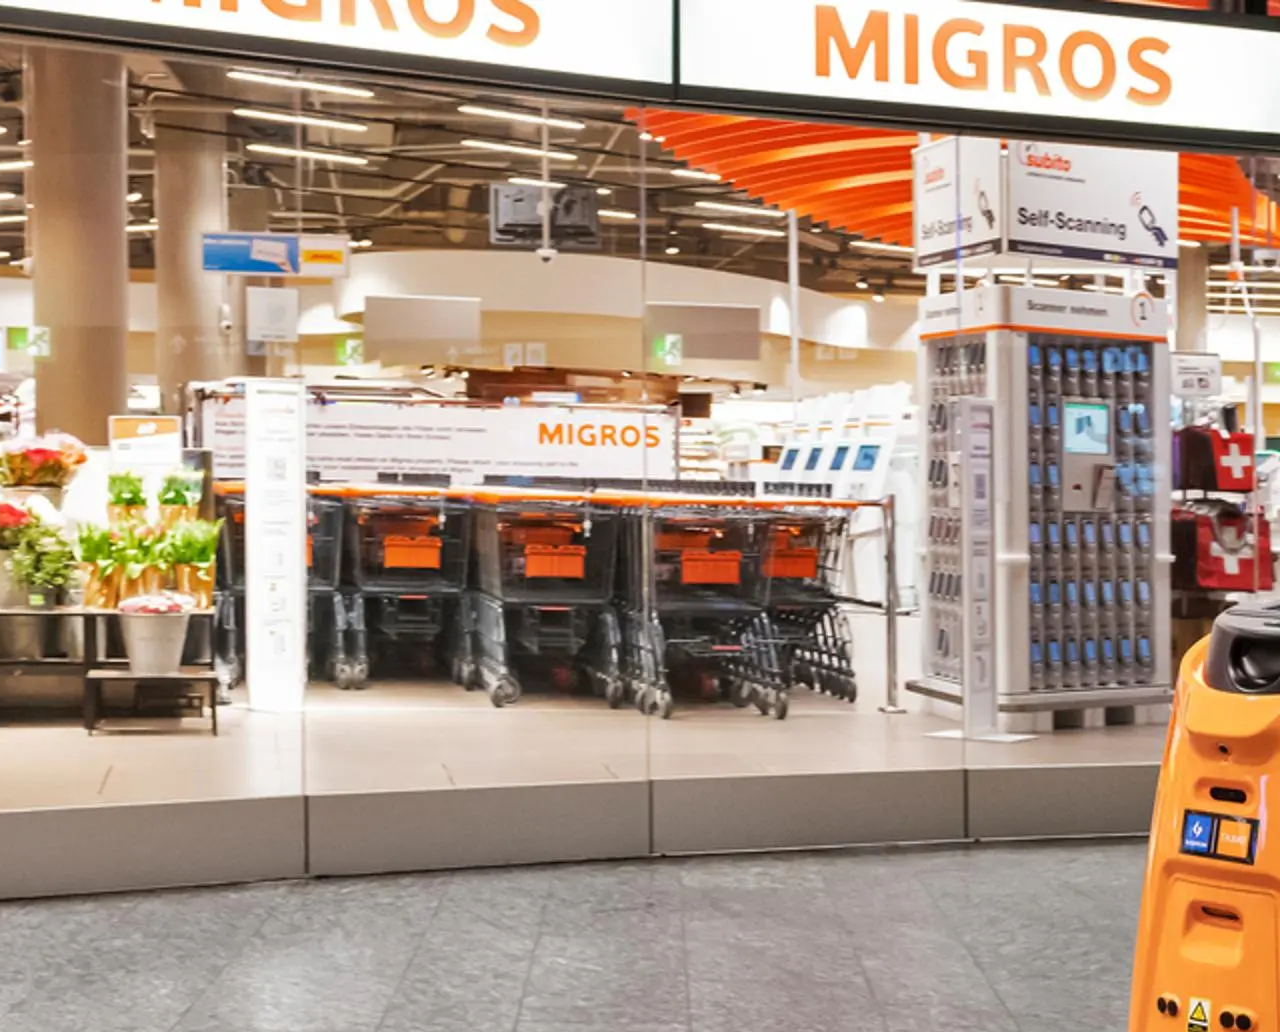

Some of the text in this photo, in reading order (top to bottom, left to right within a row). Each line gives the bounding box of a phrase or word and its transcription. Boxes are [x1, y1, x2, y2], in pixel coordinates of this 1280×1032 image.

[814, 5, 1173, 107] MIGROS
[1017, 206, 1127, 241] Self-Scanning
[538, 422, 661, 448] MIGROS
